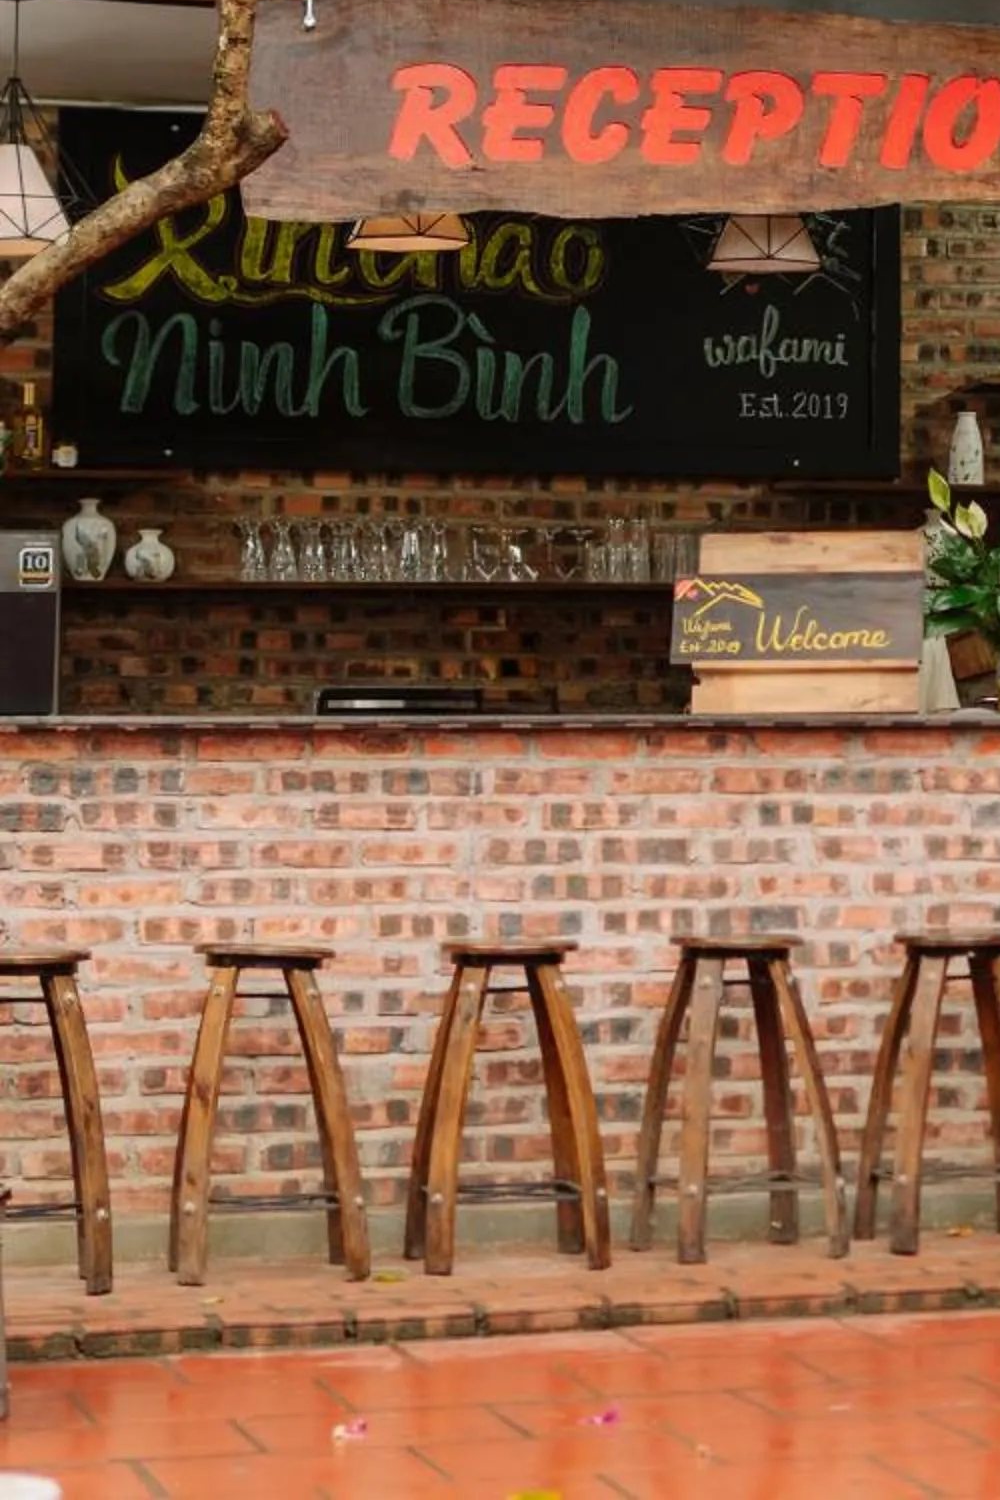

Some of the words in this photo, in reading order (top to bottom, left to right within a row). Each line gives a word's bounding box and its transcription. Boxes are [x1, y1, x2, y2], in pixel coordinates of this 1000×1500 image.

[102, 302, 368, 417] Ninh
[378, 294, 634, 423] Bình
[704, 304, 848, 378] wafami
[24, 555, 47, 570] 10
[756, 605, 891, 653] Welcome
